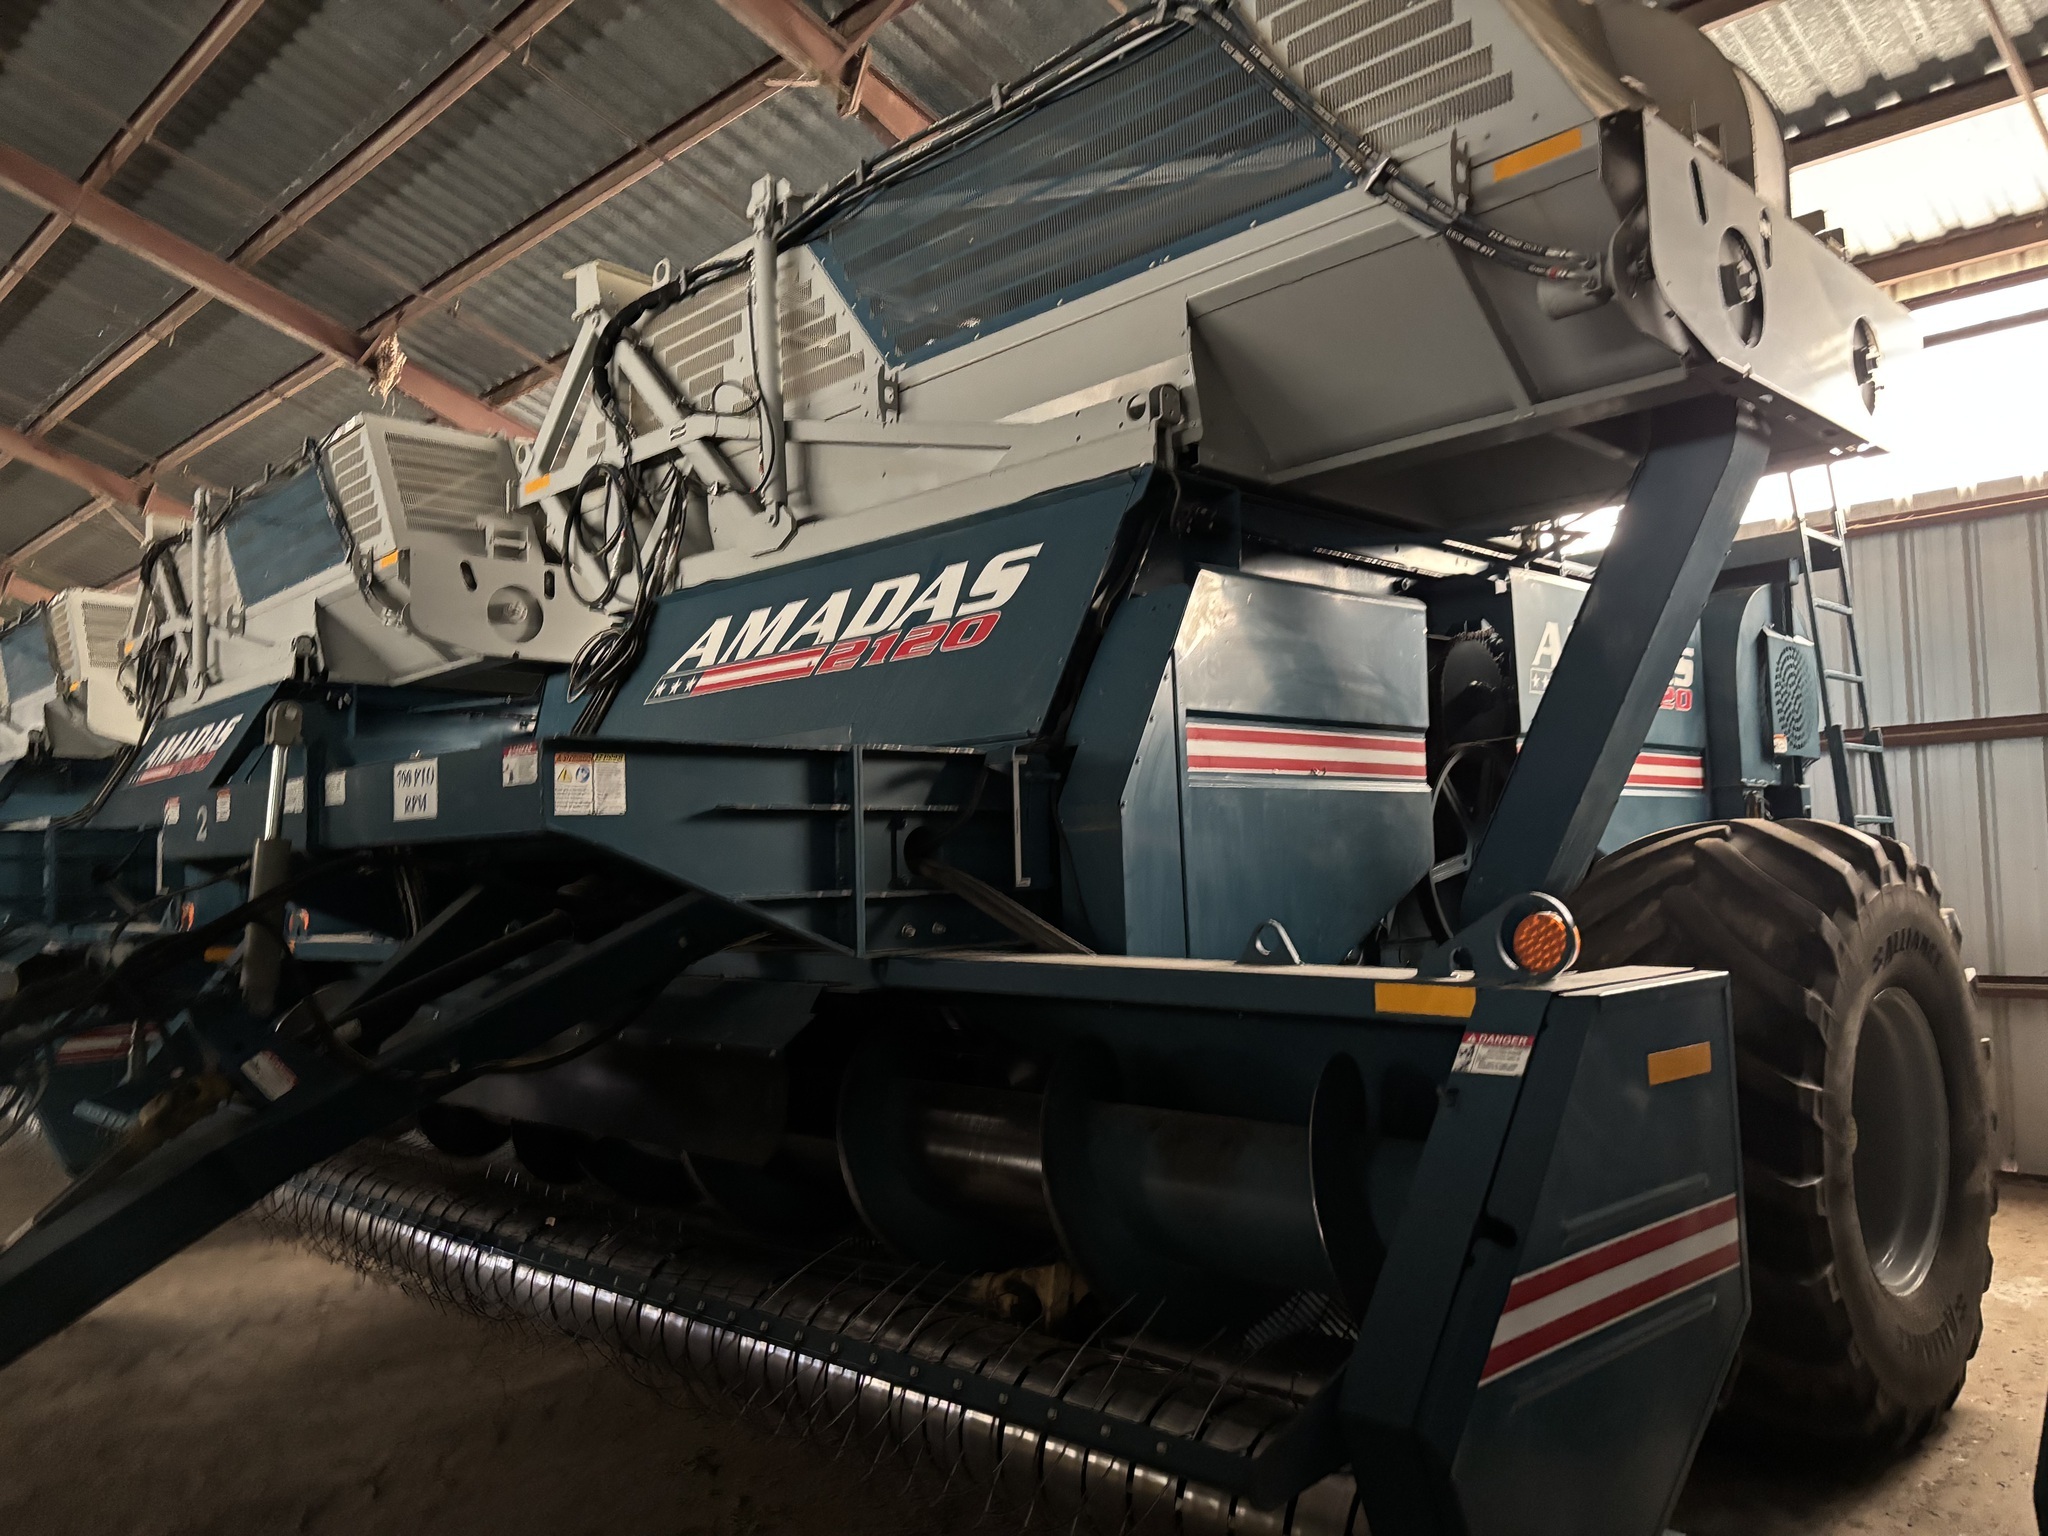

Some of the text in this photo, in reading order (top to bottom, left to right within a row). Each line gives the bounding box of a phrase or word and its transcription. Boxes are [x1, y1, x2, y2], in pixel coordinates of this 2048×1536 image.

[666, 542, 1044, 674] AMADAS
[814, 610, 1002, 675] 2120
[136, 713, 244, 770] AMADAS
[195, 804, 208, 842] 2
[404, 793, 428, 815] RPM
[1478, 1033, 1529, 1046] DANGER
